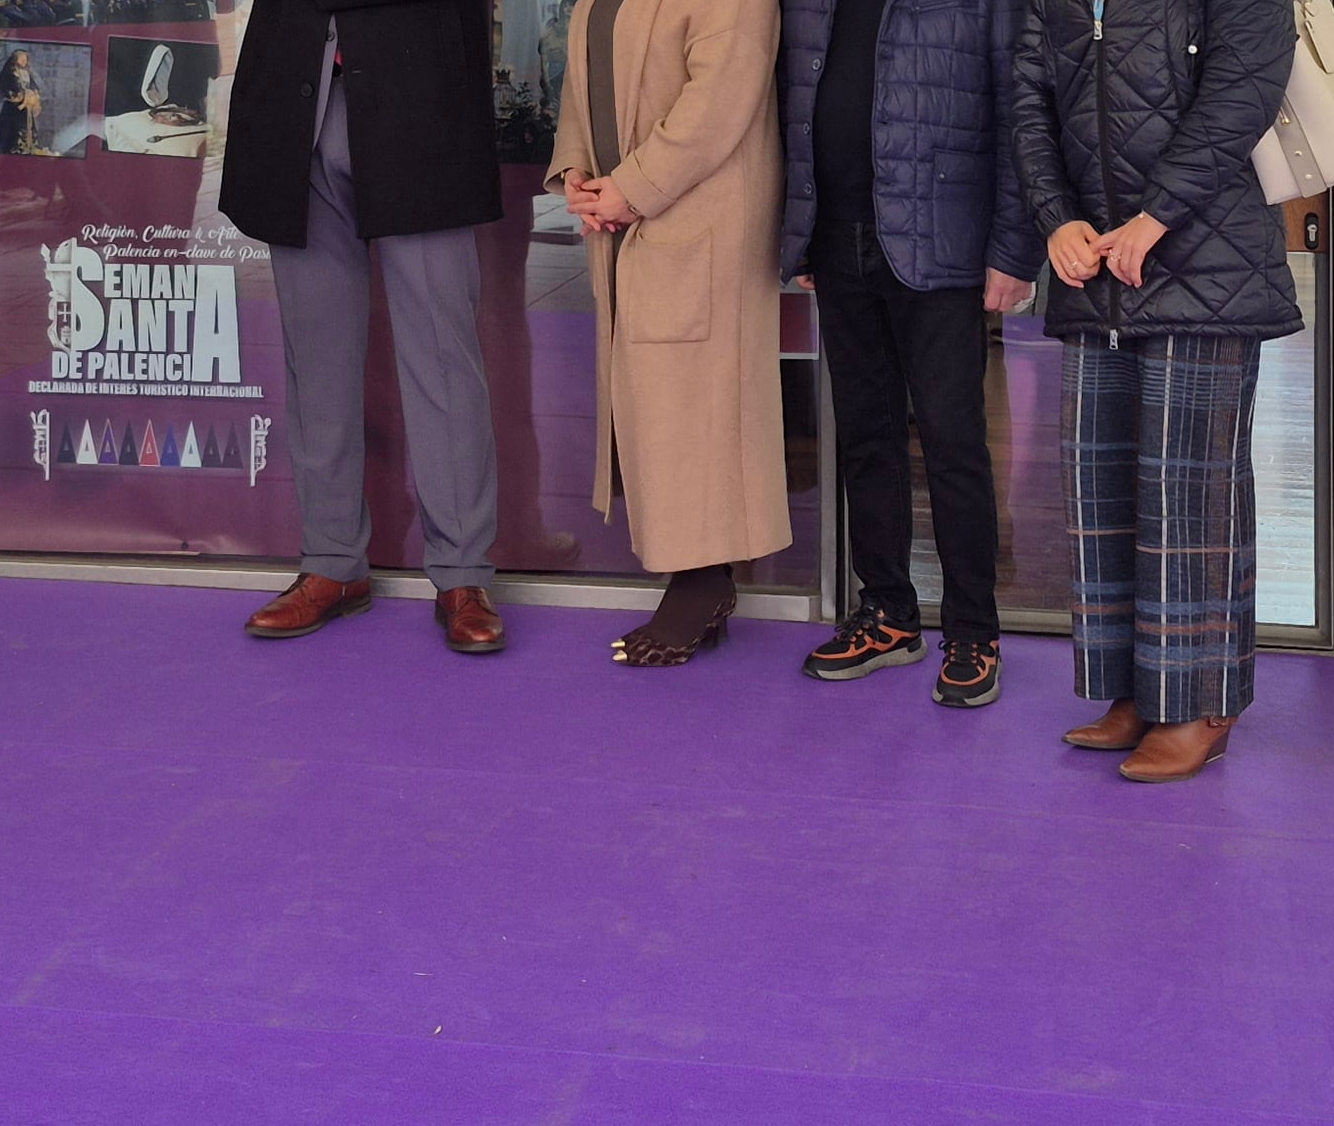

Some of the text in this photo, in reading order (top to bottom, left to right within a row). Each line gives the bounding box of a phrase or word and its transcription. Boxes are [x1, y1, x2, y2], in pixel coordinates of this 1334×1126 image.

[142, 224, 190, 243] Cultura
[103, 243, 160, 261] Palencia
[219, 244, 236, 258] de
[52, 351, 83, 379] DE
[28, 380, 85, 394] DECLARADA
[85, 382, 99, 394] DE
[189, 384, 264, 398] INTERNACIONAL
